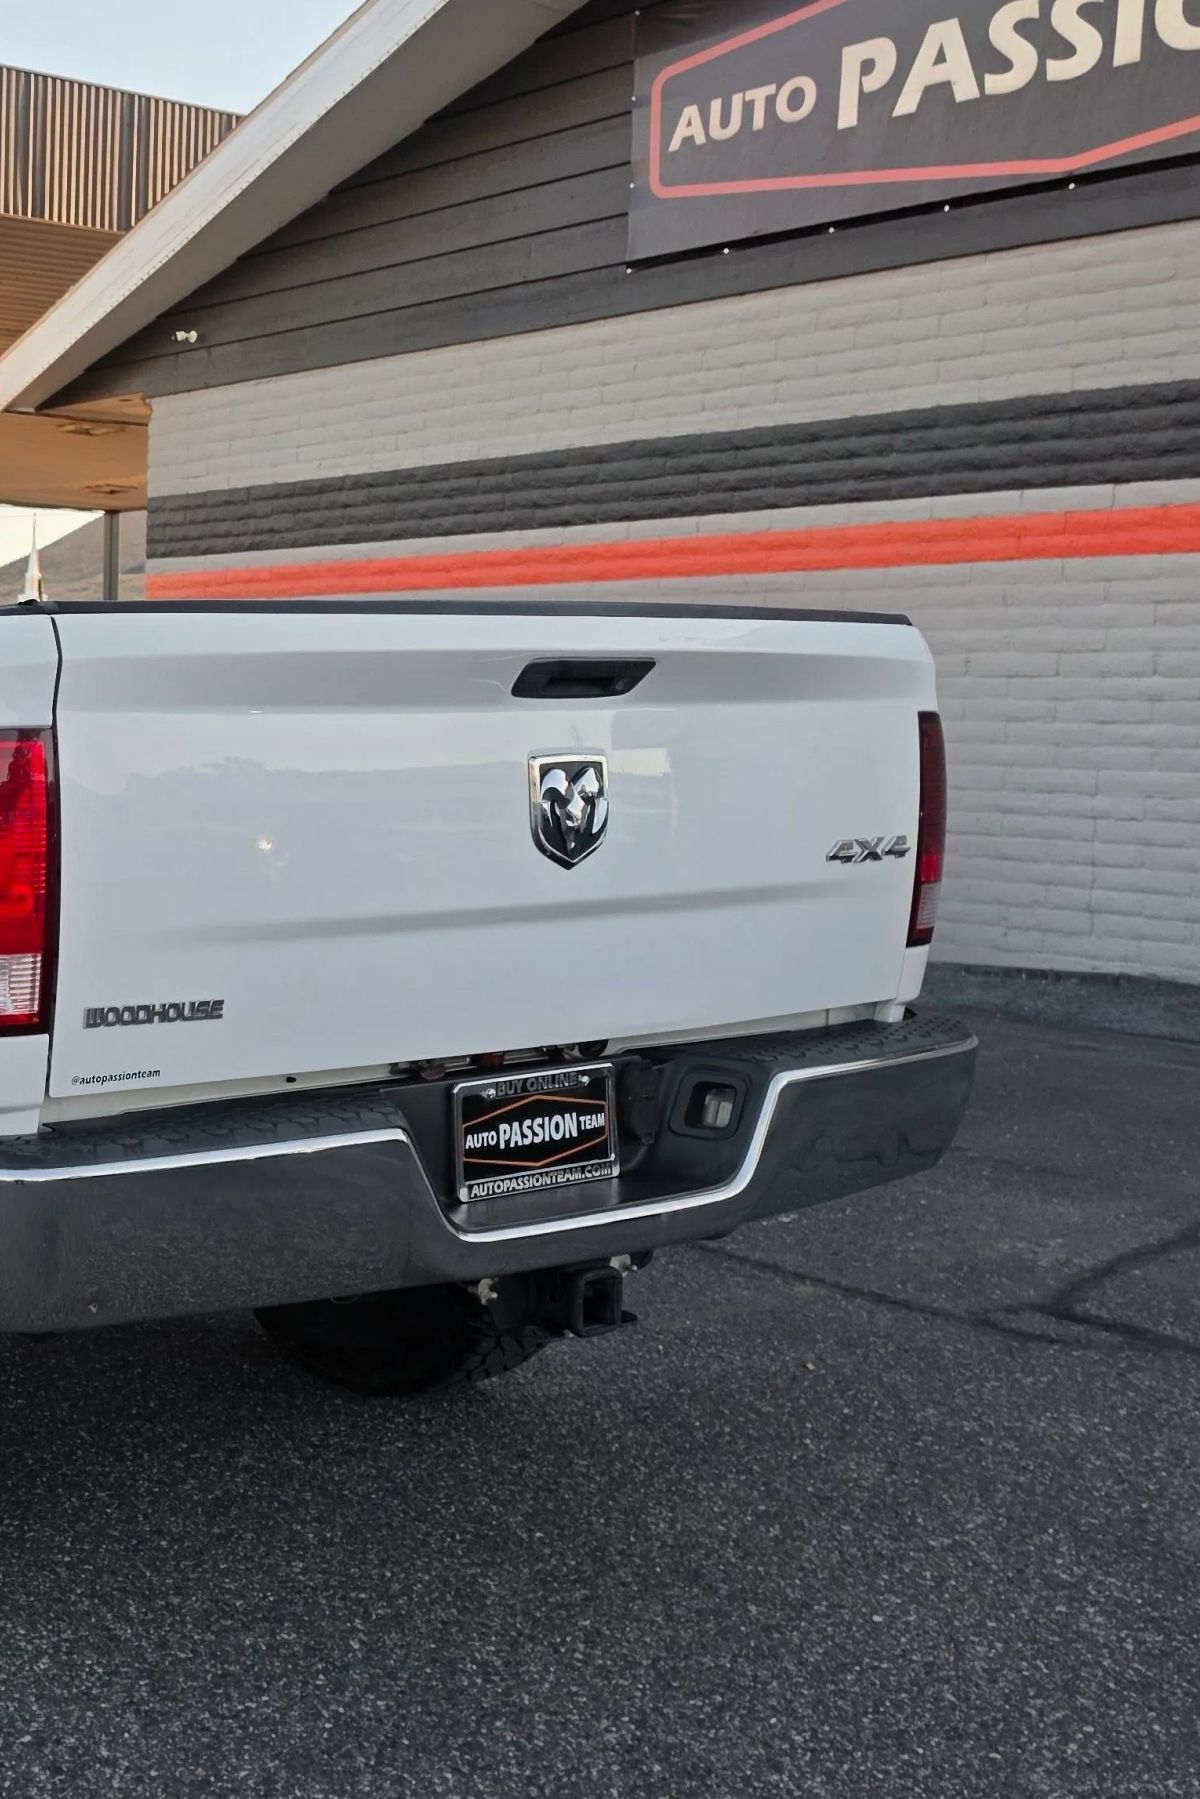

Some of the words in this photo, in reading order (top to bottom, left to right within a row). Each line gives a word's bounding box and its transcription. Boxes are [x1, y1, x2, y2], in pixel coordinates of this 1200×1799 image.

[667, 75, 817, 152] AUTO
[837, 0, 1200, 131] PASSI
[826, 834, 912, 864] 4X4
[83, 999, 225, 1029] WOODHOUSE
[71, 1068, 161, 1086] @autopassionteam
[496, 1080, 524, 1096] BUY
[526, 1072, 578, 1092] ONLINE
[465, 1130, 498, 1150] AUTO
[499, 1112, 578, 1150] PASSION
[579, 1112, 606, 1131] TEAM
[470, 1162, 613, 1199] AUTOPASSIONTEAM.COM
